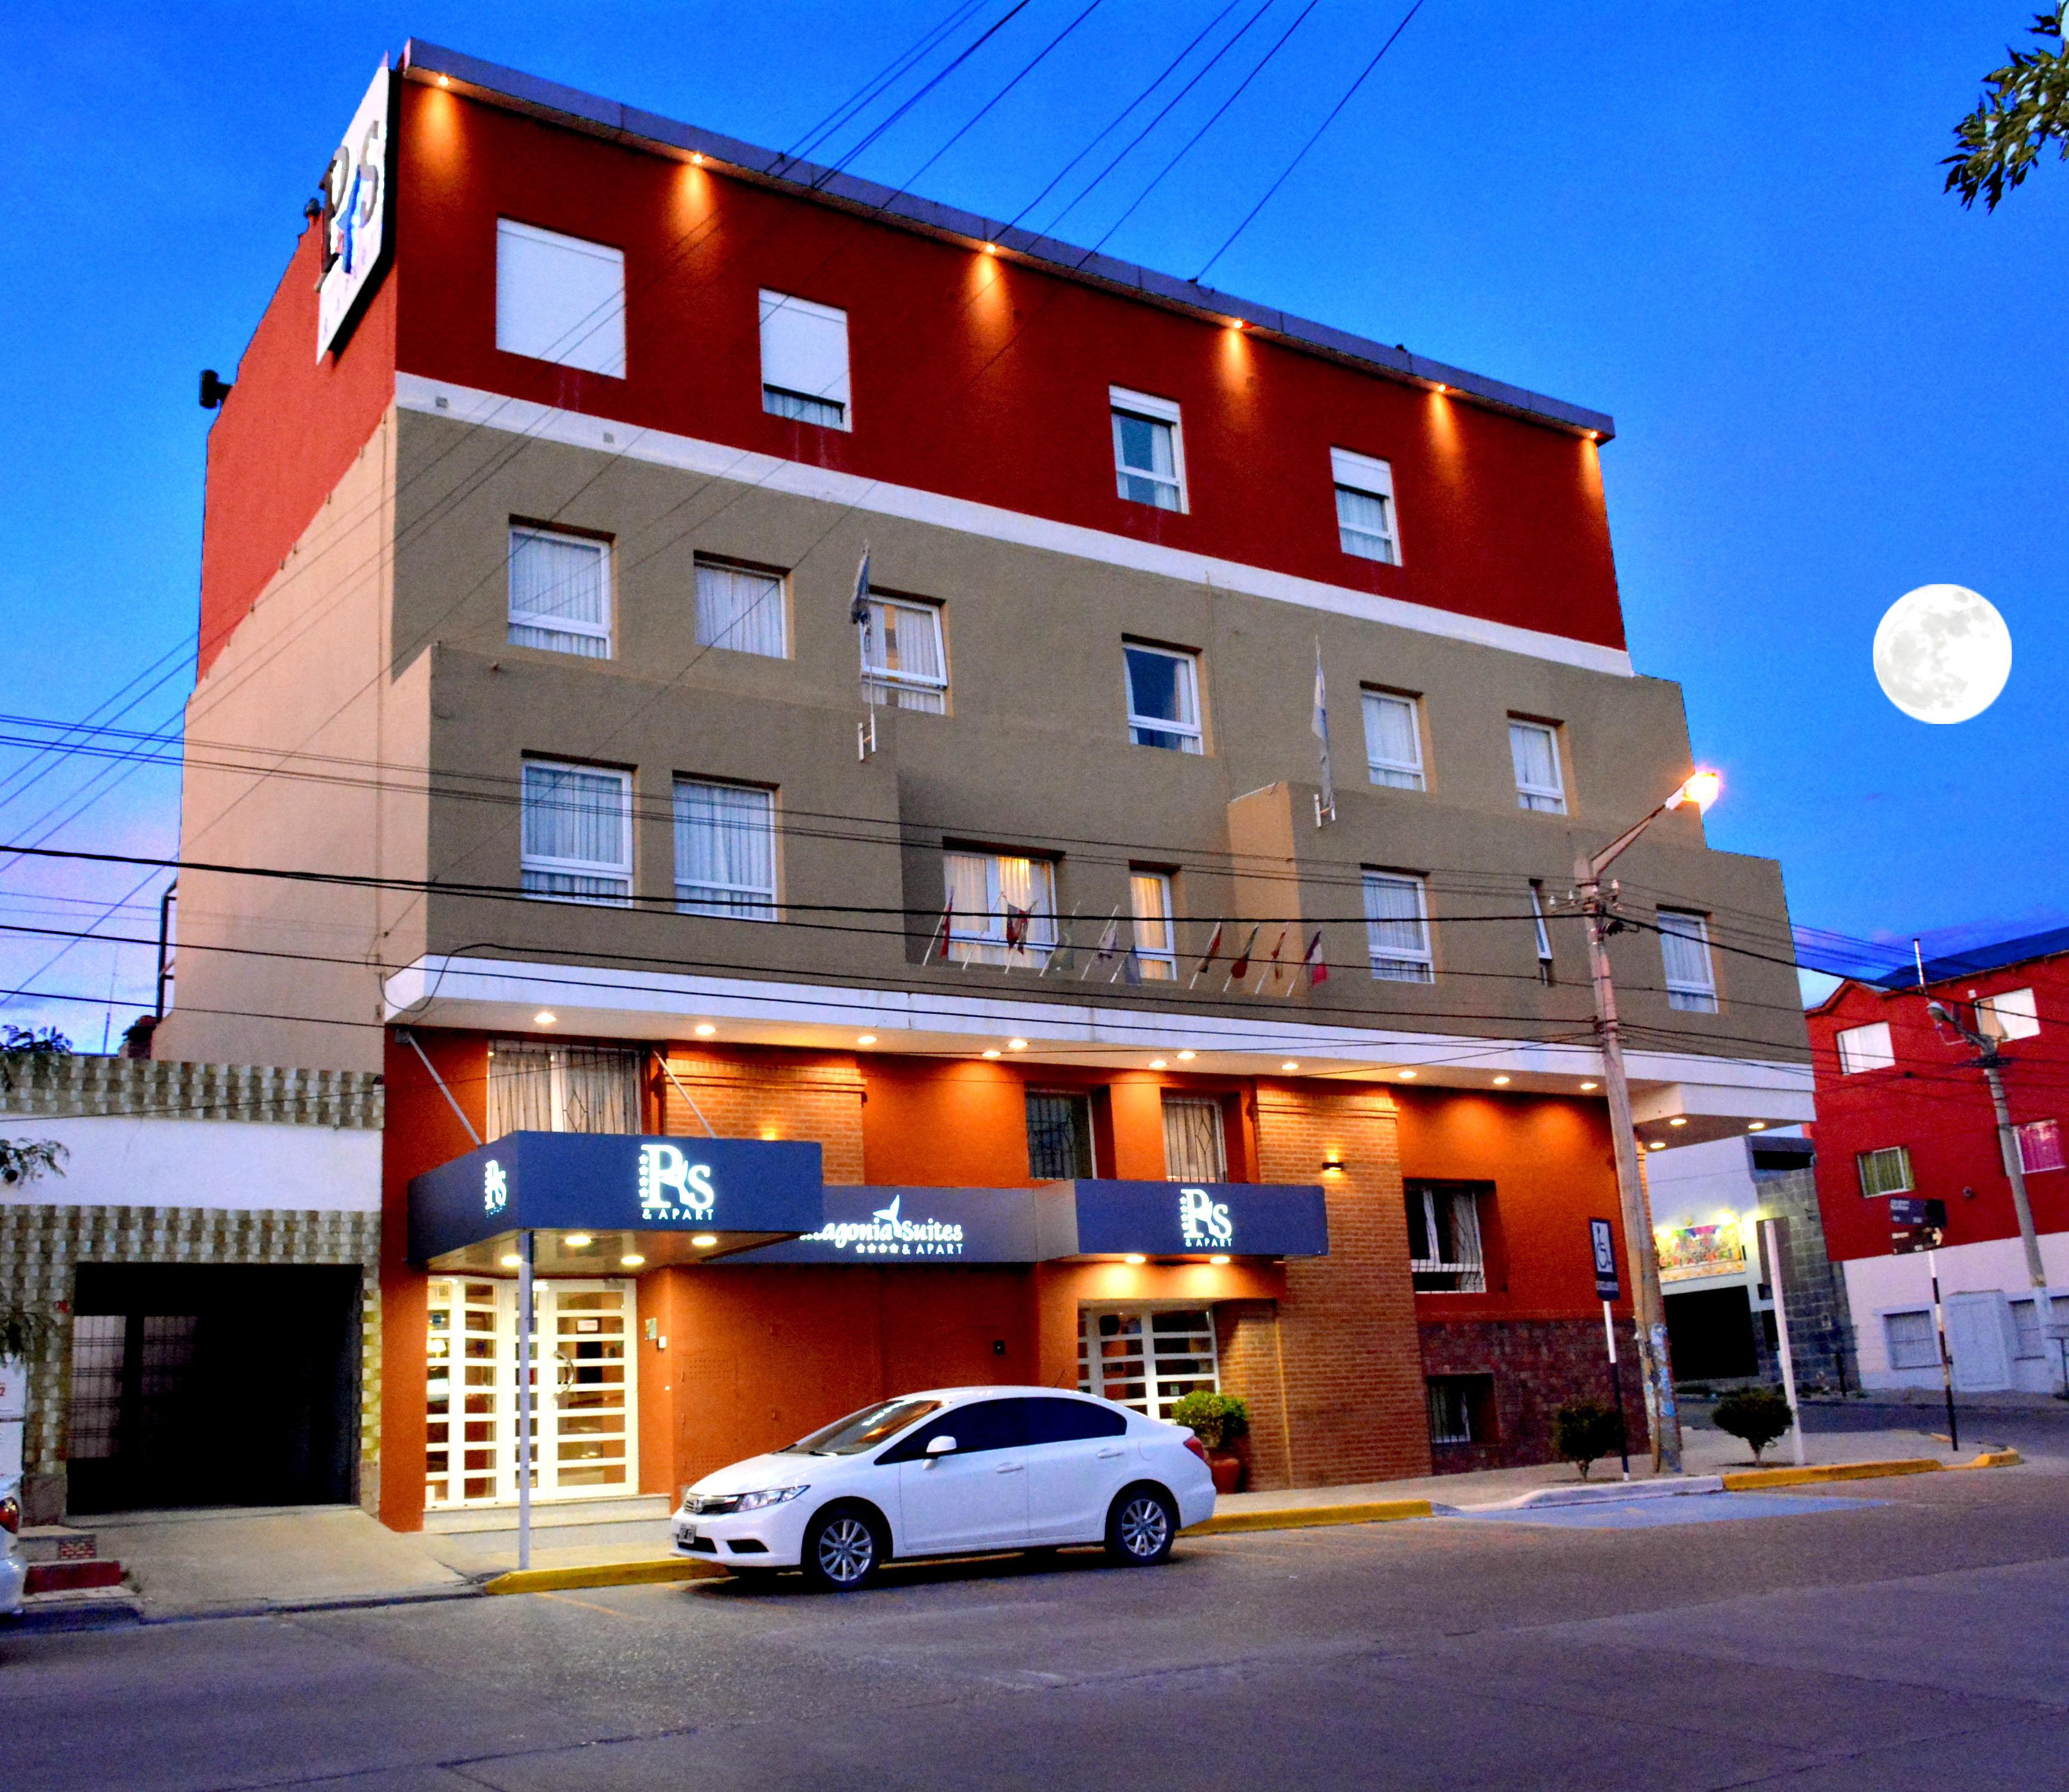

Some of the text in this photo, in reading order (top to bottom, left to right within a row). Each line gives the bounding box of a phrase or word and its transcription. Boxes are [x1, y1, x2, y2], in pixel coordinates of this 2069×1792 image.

[642, 1208, 714, 1220] & APART
[799, 1217, 963, 1248] agonia Suites
[1196, 1238, 1232, 1247] APART
[902, 1244, 963, 1254] & APART
